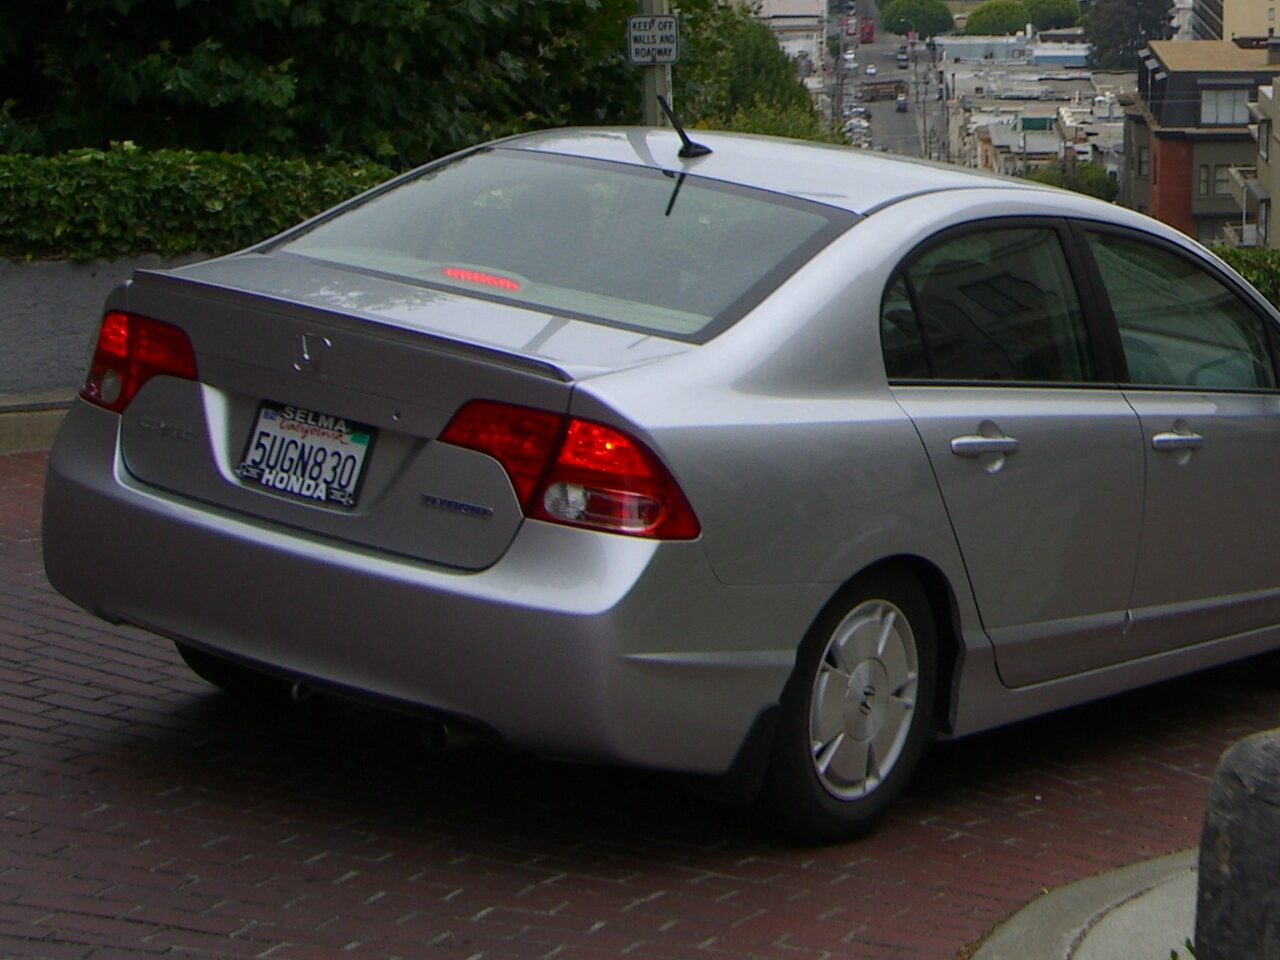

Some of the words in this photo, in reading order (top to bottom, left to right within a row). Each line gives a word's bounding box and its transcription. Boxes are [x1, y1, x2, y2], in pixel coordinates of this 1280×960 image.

[632, 21, 654, 31] KEEP
[658, 21, 674, 31] OFF
[632, 35, 657, 45] WALLS
[660, 34, 675, 44] AND
[634, 47, 673, 57] ROADWAY
[283, 406, 350, 434] SELMA
[251, 430, 357, 489] 5UGN830
[261, 468, 327, 500] HONDA
